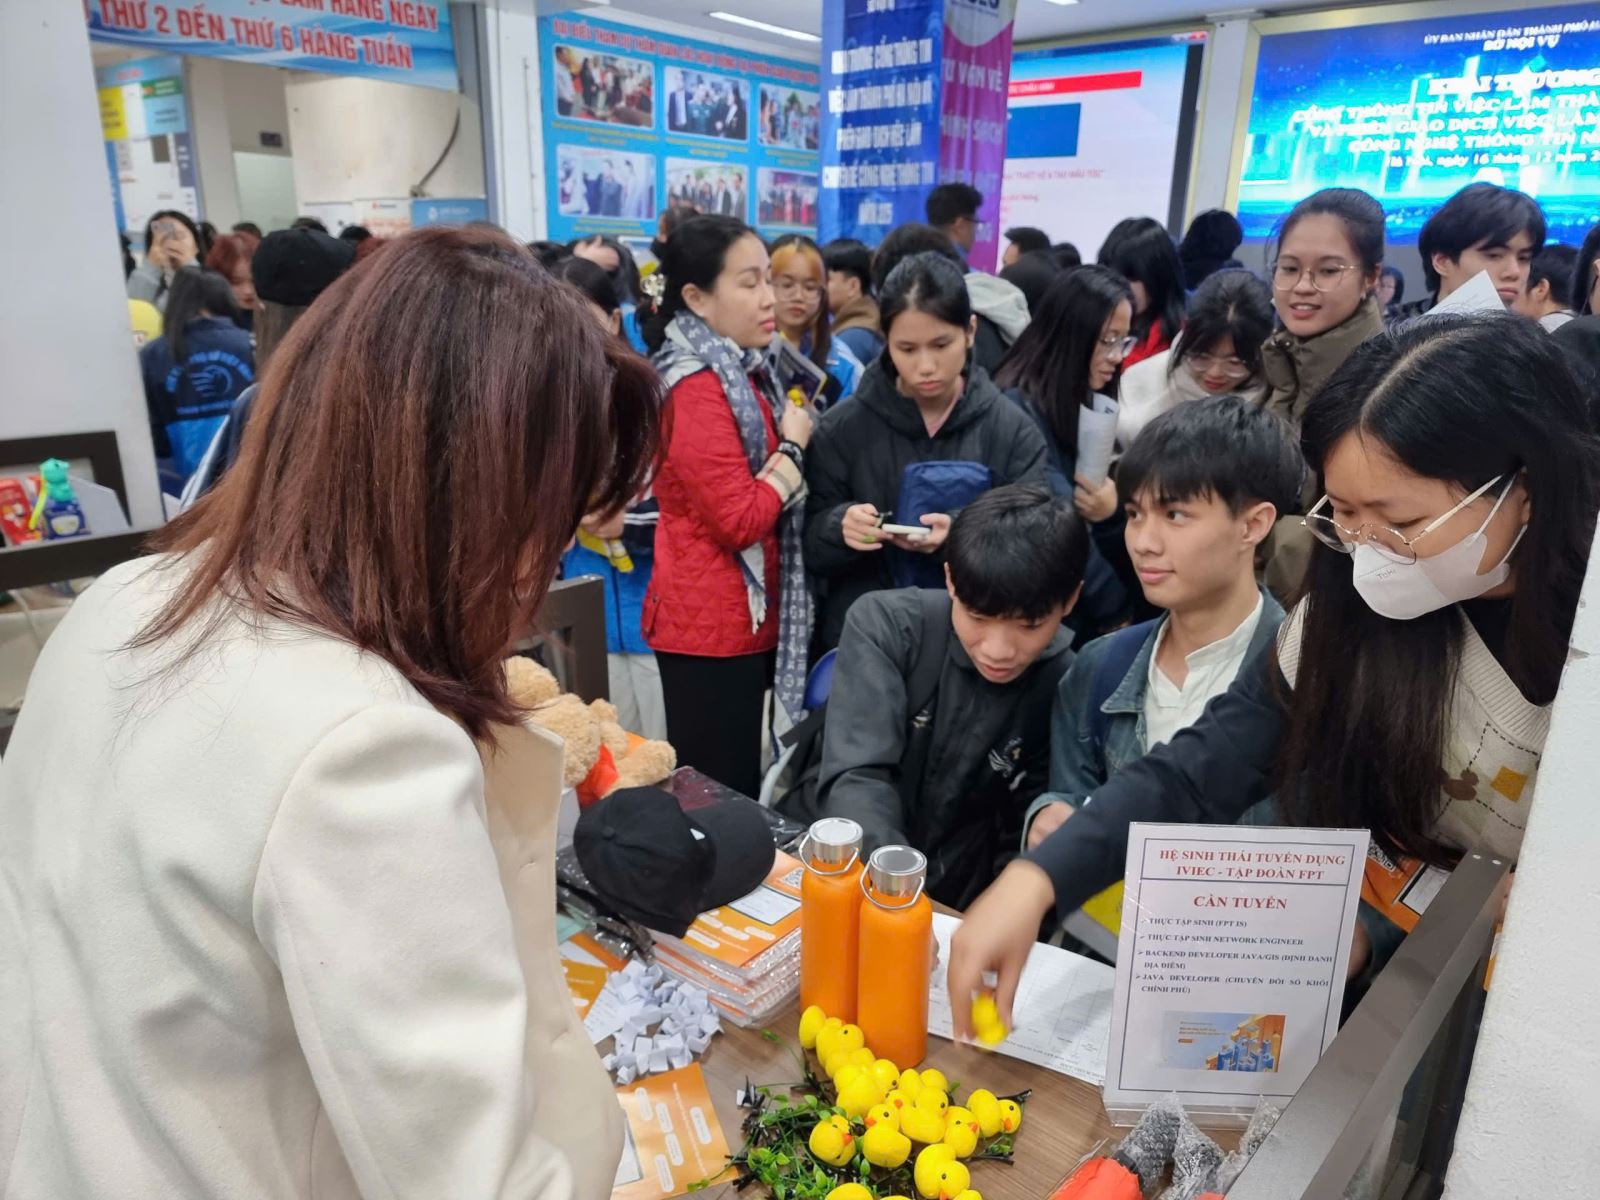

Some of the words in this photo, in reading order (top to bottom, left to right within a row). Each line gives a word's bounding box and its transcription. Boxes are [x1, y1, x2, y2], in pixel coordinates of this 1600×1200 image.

[153, 4, 173, 34] 2
[175, 3, 226, 42] ĐẾN
[230, 16, 274, 48] THỨ
[280, 25, 294, 52] 6
[299, 24, 358, 62] HÀNG
[360, 32, 413, 69] TUẦN
[1440, 32, 1464, 44] BAN
[1464, 29, 1496, 42] NHÂN
[1472, 152, 1490, 165] 16
[1159, 849, 1179, 862] HỆ
[1182, 850, 1215, 862] SINH
[1219, 851, 1252, 863] THÁI
[1256, 850, 1302, 865] TUYỂN
[1305, 855, 1346, 868] DỤNG
[1176, 866, 1215, 876] IVIEC
[1226, 867, 1253, 879] TẬP
[1256, 866, 1297, 880] ĐOÀN
[1299, 870, 1325, 881] FPT
[1193, 894, 1229, 909] CẦN
[1231, 894, 1289, 910] TUYỂN
[1193, 919, 1214, 927] SINH
[1216, 920, 1235, 928] (FPT
[1236, 920, 1248, 928] IS)
[1191, 935, 1212, 943] SINH
[1213, 936, 1259, 944] NETWORK
[1259, 937, 1305, 946] ENGINEER
[1145, 950, 1186, 958] BACKEND
[1188, 951, 1239, 960] DEVELOPER
[1240, 952, 1280, 961] JAVA/GIS
[1308, 955, 1333, 963] DANH
[1142, 973, 1165, 981] JAVA
[1169, 974, 1221, 983] DEVELOPER
[1141, 984, 1169, 993] CHÍNH
